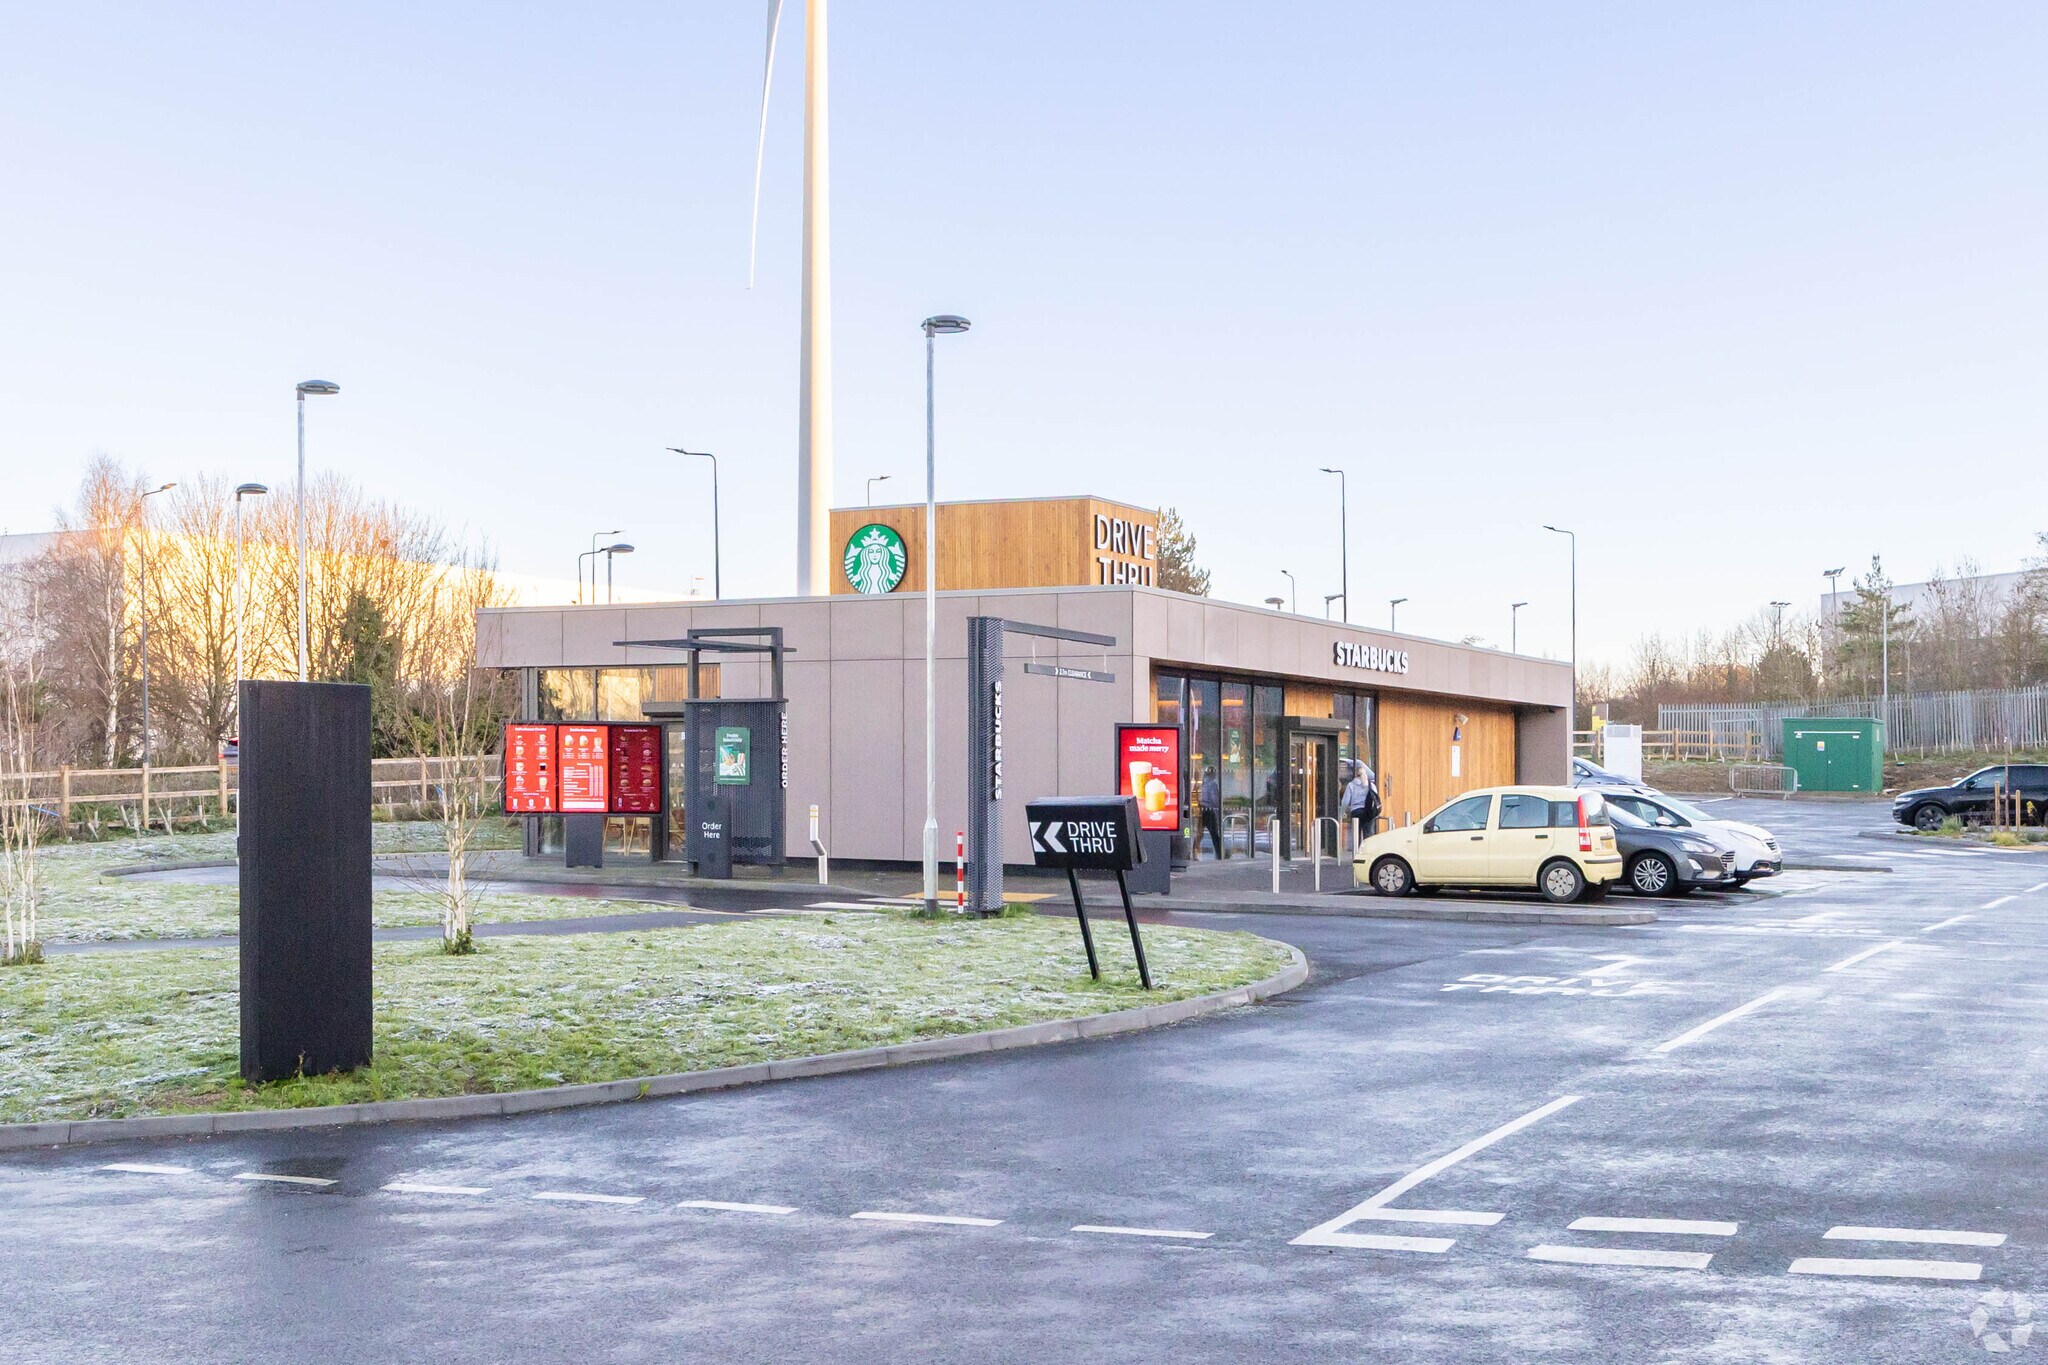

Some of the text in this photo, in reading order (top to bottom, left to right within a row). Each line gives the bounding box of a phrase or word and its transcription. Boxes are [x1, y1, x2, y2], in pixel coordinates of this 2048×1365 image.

[1095, 514, 1154, 560] DRIVE
[1097, 557, 1153, 587] THRU
[1334, 641, 1409, 674] STARBUCKS
[994, 681, 1002, 800] STARBUCKS
[1136, 737, 1162, 745] Matcha
[702, 822, 722, 830] Order
[1067, 822, 1117, 838] DRIVE
[703, 831, 720, 839] Here
[1069, 837, 1114, 853] THRU
